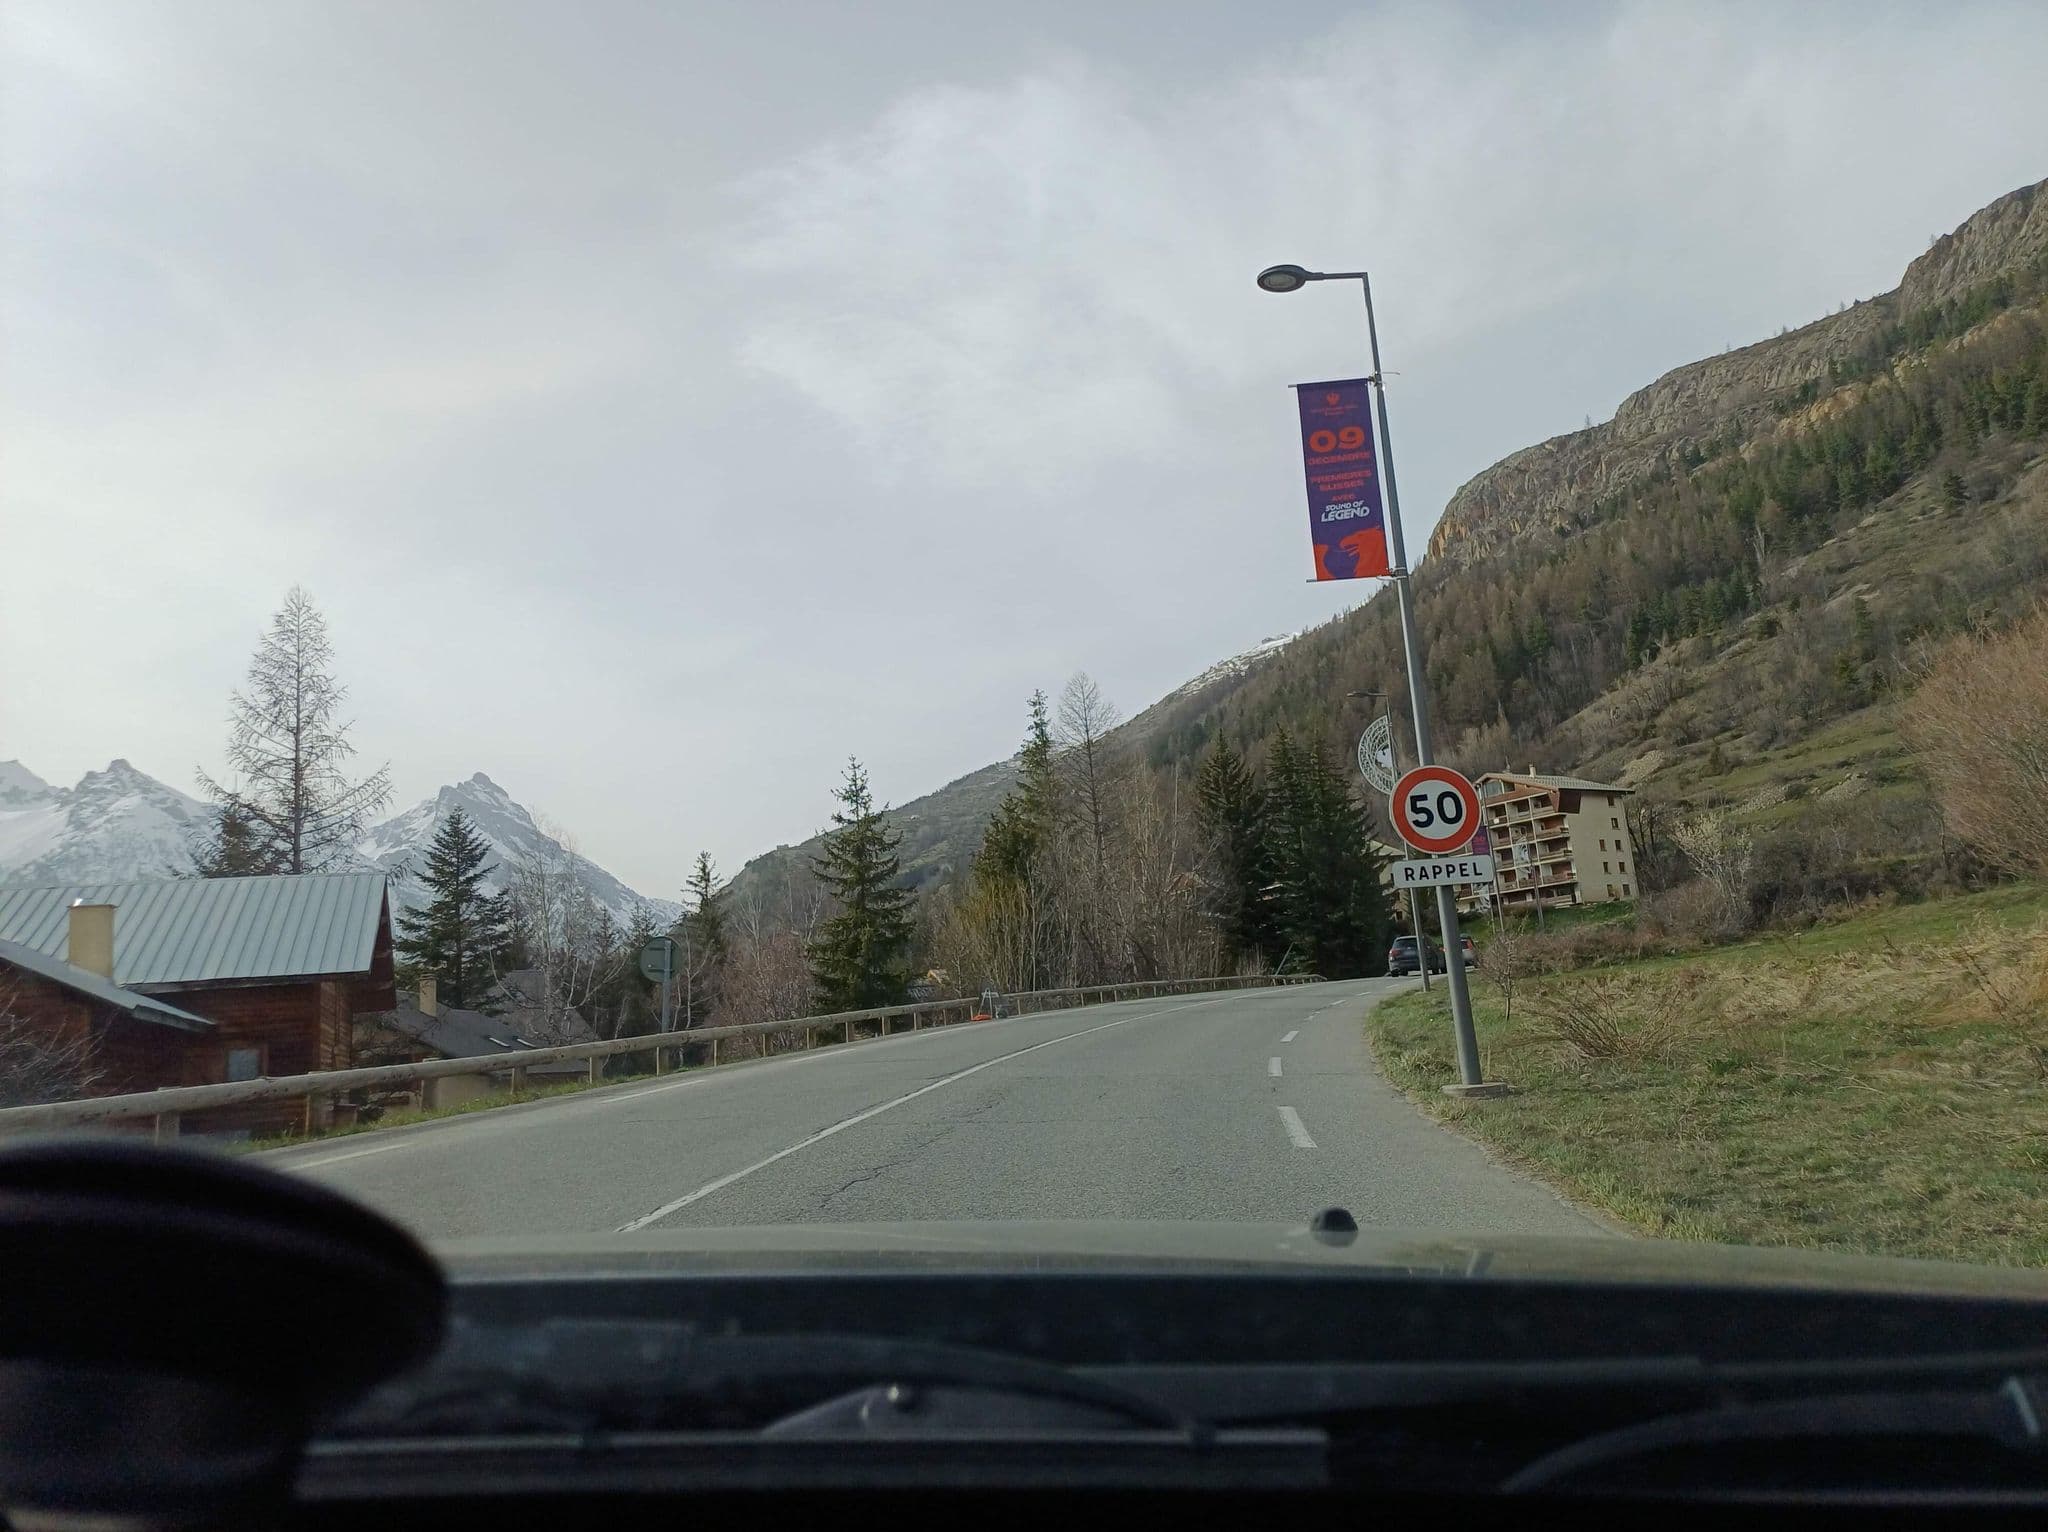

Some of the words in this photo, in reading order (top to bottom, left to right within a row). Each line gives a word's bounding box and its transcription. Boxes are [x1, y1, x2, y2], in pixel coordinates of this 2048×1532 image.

[1309, 426, 1365, 452] 09
[1320, 506, 1370, 522] LEGEND
[1325, 502, 1352, 511] SOUND
[1352, 500, 1365, 509] OF
[1410, 791, 1463, 828] 50
[1404, 862, 1483, 881] RAPPEL
